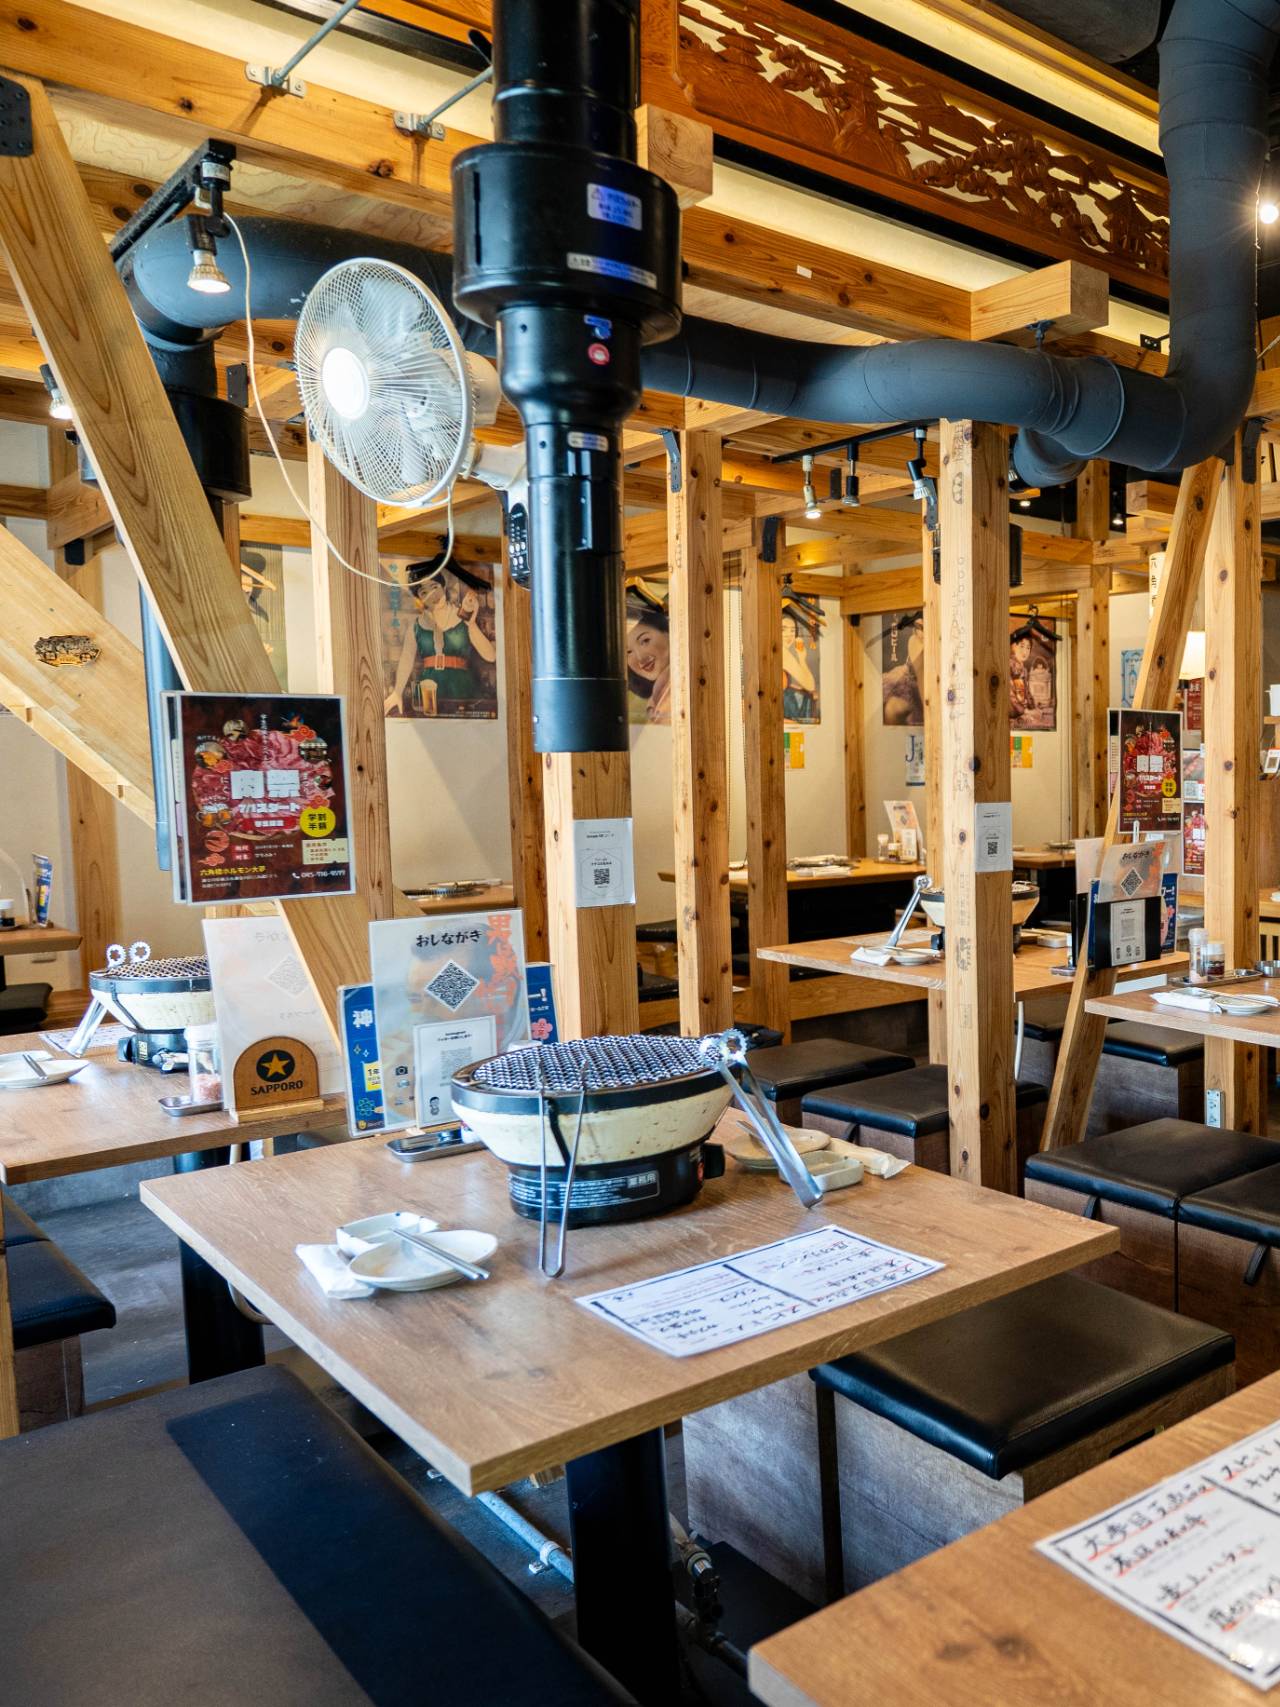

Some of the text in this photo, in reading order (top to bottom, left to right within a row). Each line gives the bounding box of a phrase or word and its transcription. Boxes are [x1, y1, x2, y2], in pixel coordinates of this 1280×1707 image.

[416, 929, 483, 948] おしながき
[250, 1080, 304, 1096] SAPPORO
